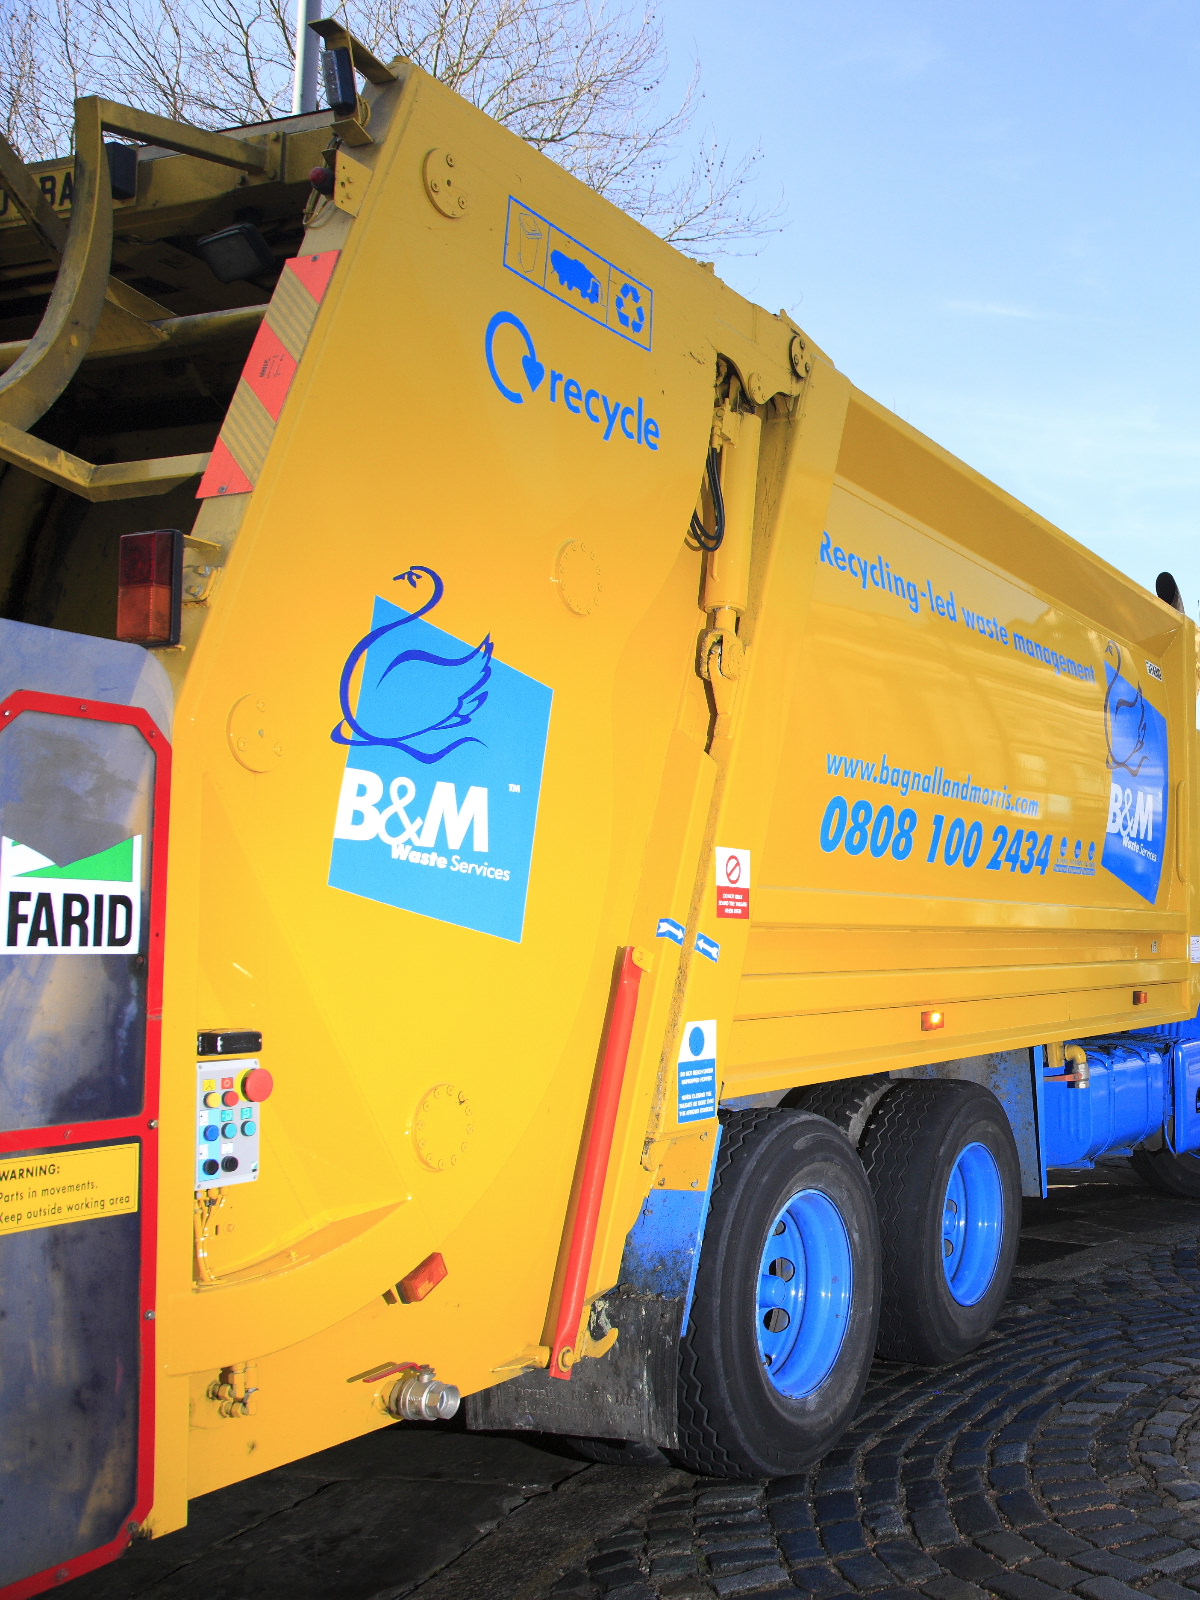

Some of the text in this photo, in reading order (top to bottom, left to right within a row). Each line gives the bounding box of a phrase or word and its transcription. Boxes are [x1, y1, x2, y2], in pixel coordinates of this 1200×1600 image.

[550, 369, 662, 451] recycle
[820, 530, 1097, 685] Recycling-led waste management
[334, 767, 488, 852] B&M
[826, 752, 1039, 817] www.bagnallandmorris.com
[1106, 783, 1153, 842] B&M
[391, 843, 511, 881] Waste Services
[820, 795, 1054, 876] 0808 100 2434
[1122, 835, 1157, 862] Waste Services
[6, 891, 132, 946] FARID
[0, 1164, 60, 1181] WARNING:
[28, 1187, 37, 1199] in
[42, 1180, 98, 1197] movements.
[27, 1202, 62, 1219] outside
[66, 1197, 104, 1212] working
[110, 1195, 130, 1206] area
